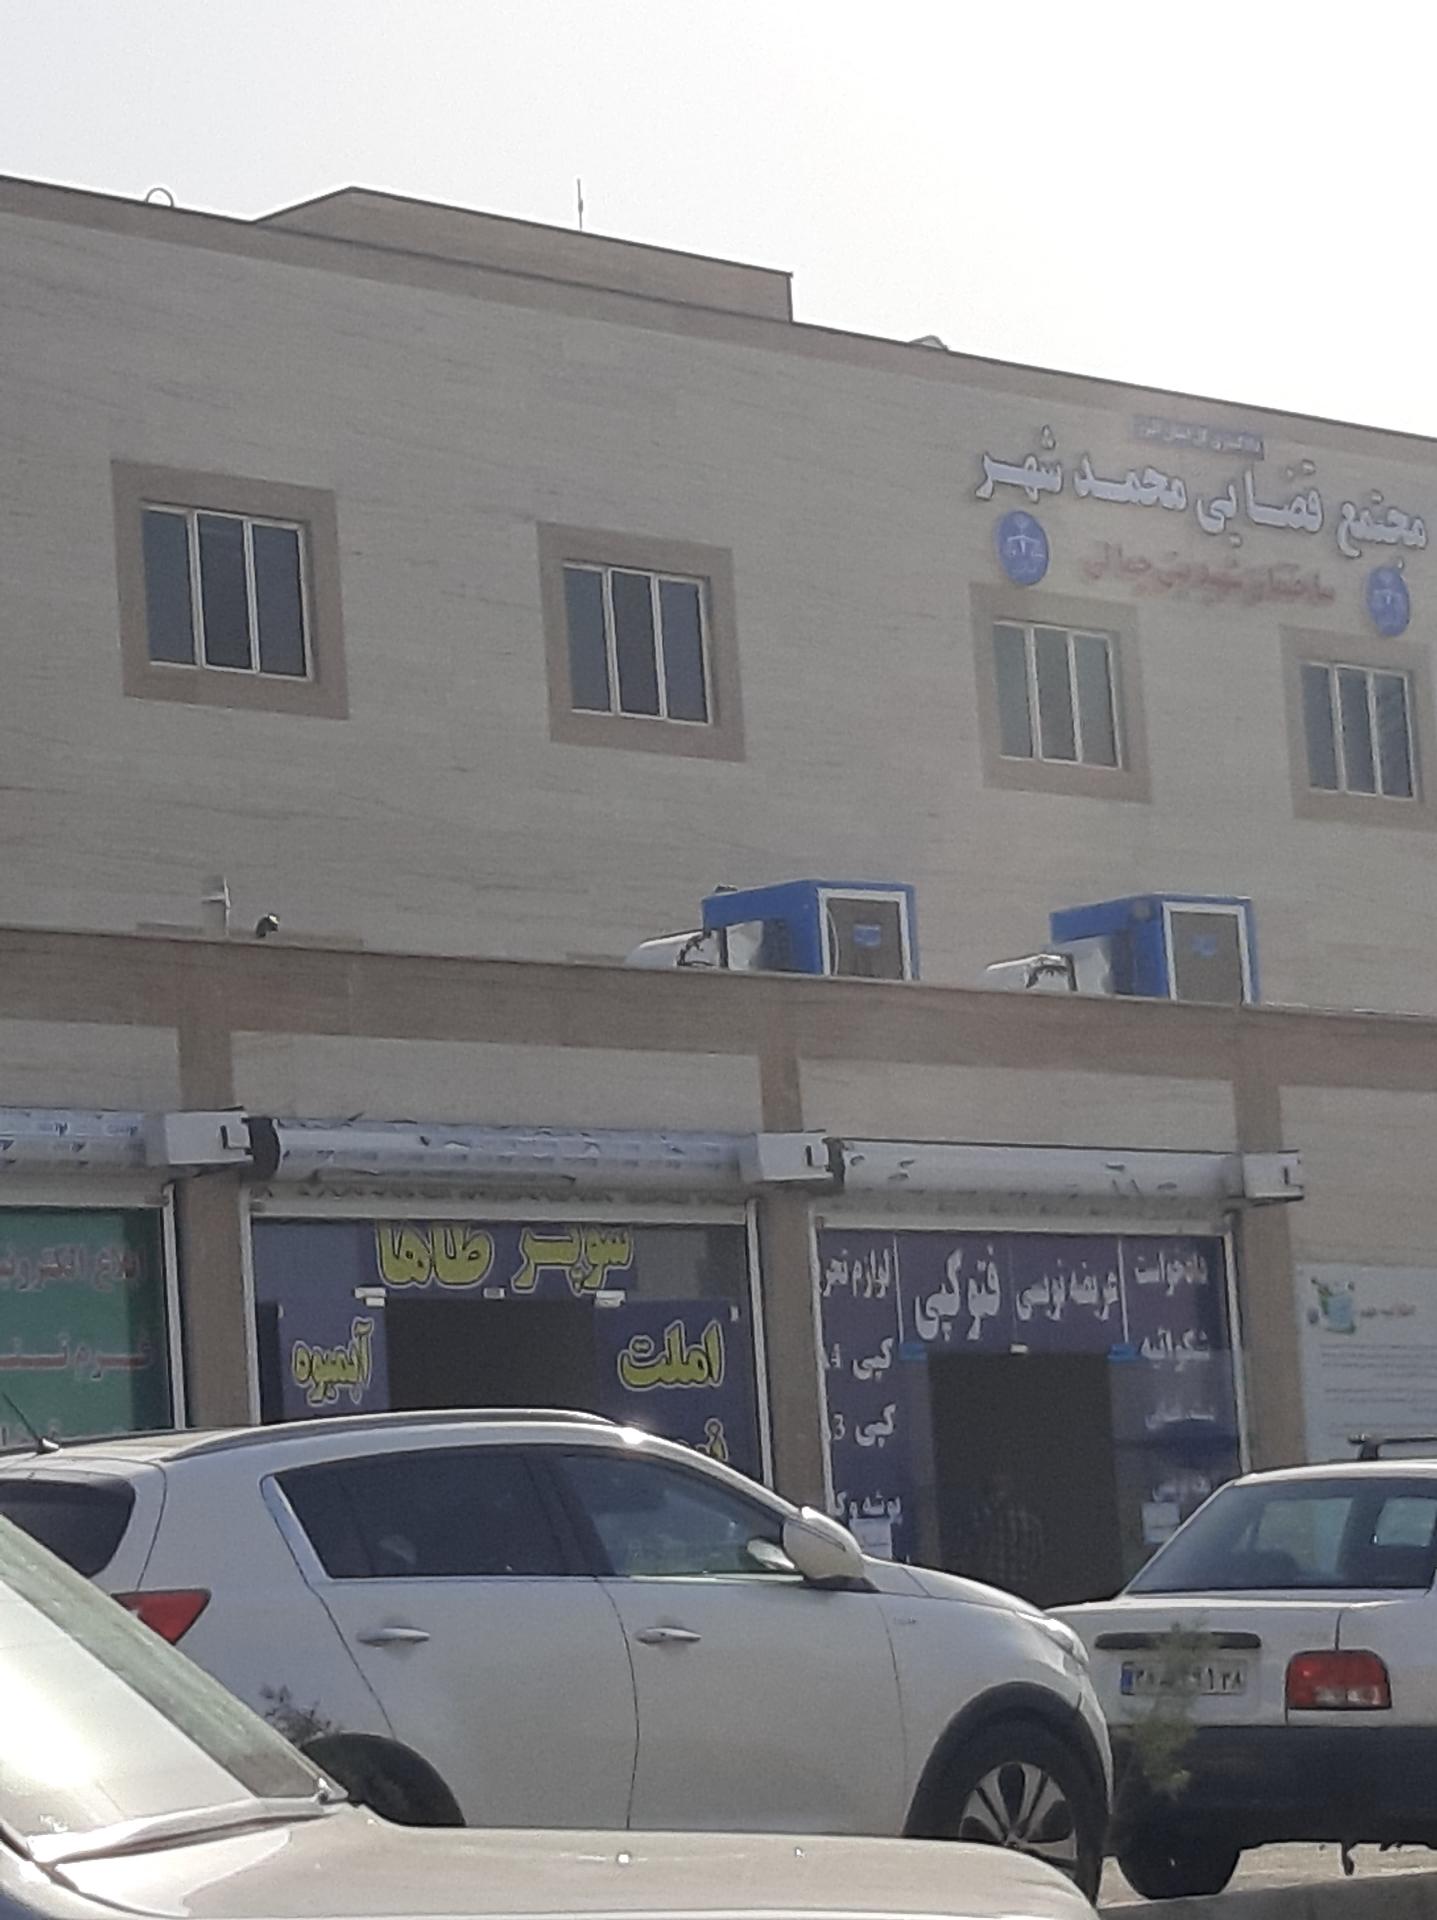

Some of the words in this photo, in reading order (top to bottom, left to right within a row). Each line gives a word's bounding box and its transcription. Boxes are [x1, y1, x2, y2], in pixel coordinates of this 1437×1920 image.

[975, 425, 1063, 503] شهر
[1074, 455, 1188, 513] محمد
[1197, 459, 1324, 548] قضایی
[1337, 489, 1428, 570] مجتمع
[375, 1222, 495, 1289] طاها
[512, 1226, 634, 1297] سوپر
[853, 1247, 890, 1299] لوازم
[292, 1316, 375, 1408] آبمیوه
[617, 1320, 725, 1391] املت
[853, 1338, 894, 1381] کپی
[855, 1404, 897, 1449] کپی
